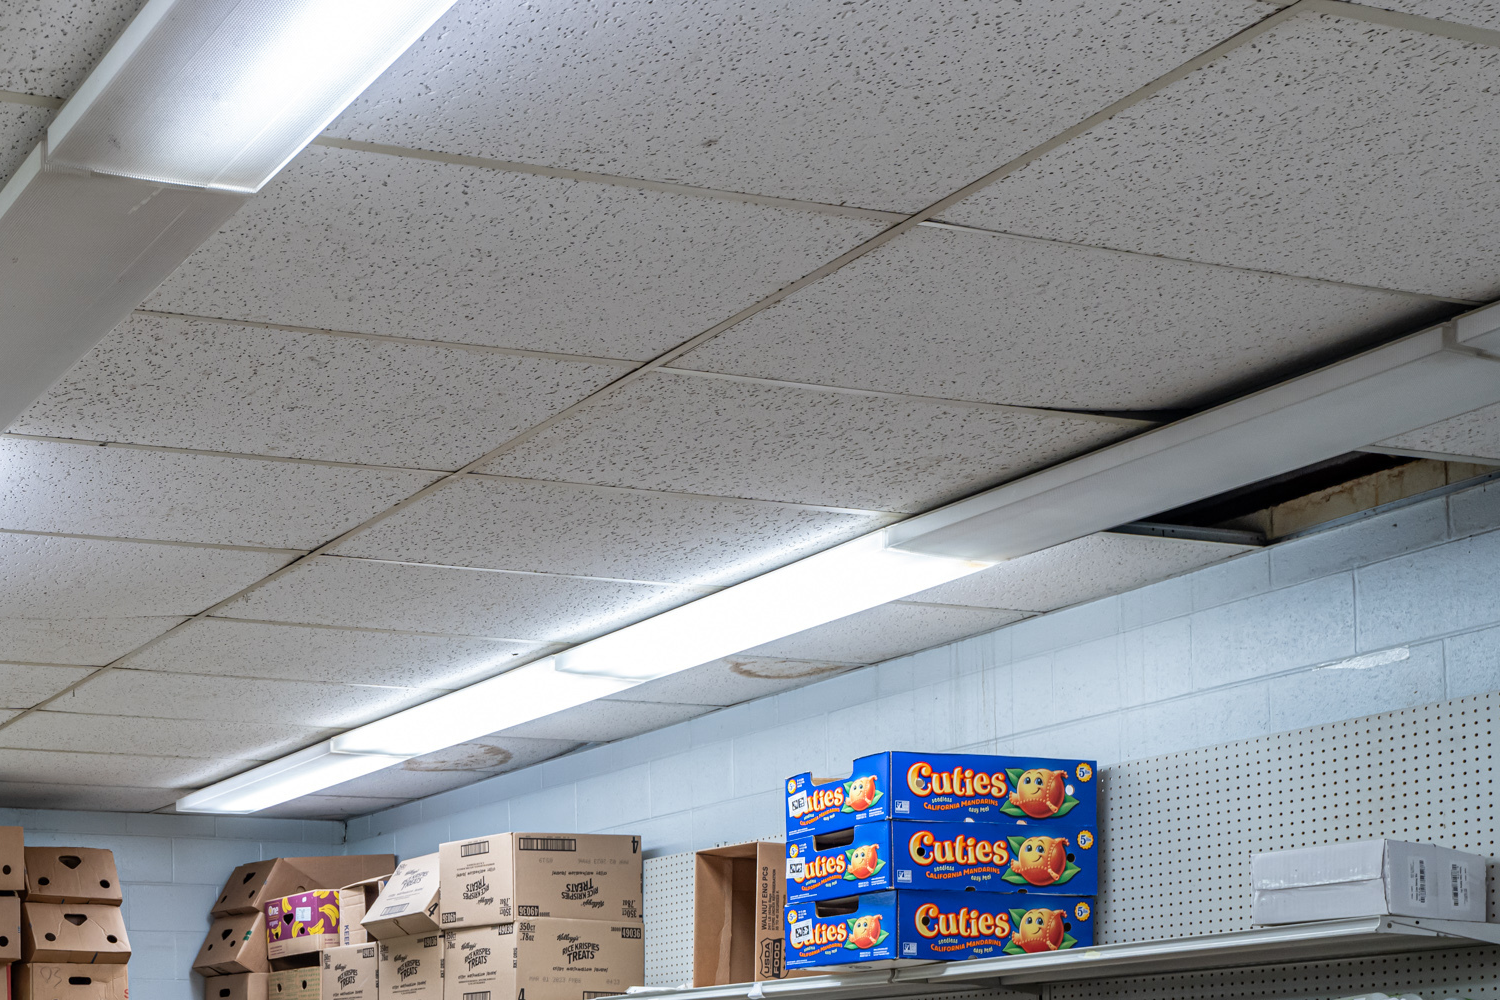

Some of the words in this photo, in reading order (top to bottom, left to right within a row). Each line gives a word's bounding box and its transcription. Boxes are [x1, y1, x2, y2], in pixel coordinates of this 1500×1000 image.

[907, 761, 1008, 797] Cuties
[923, 802, 960, 811] CALIFORNIA
[961, 798, 998, 808] MANDARINS
[908, 830, 1009, 867] Cuties
[925, 870, 963, 880] CALIFORNIA
[963, 866, 1000, 876] MANDARINS
[466, 875, 486, 892] TREATS
[566, 878, 594, 891] TREATS
[914, 902, 1011, 939] Cuties
[622, 928, 641, 938] 49036
[562, 945, 574, 955] RICE
[575, 942, 600, 952] KRISPIES
[930, 943, 965, 952] CALIFORNIA
[966, 939, 1001, 948] MANDARINS
[468, 955, 488, 971] TREATS
[567, 951, 595, 964] TREATS
